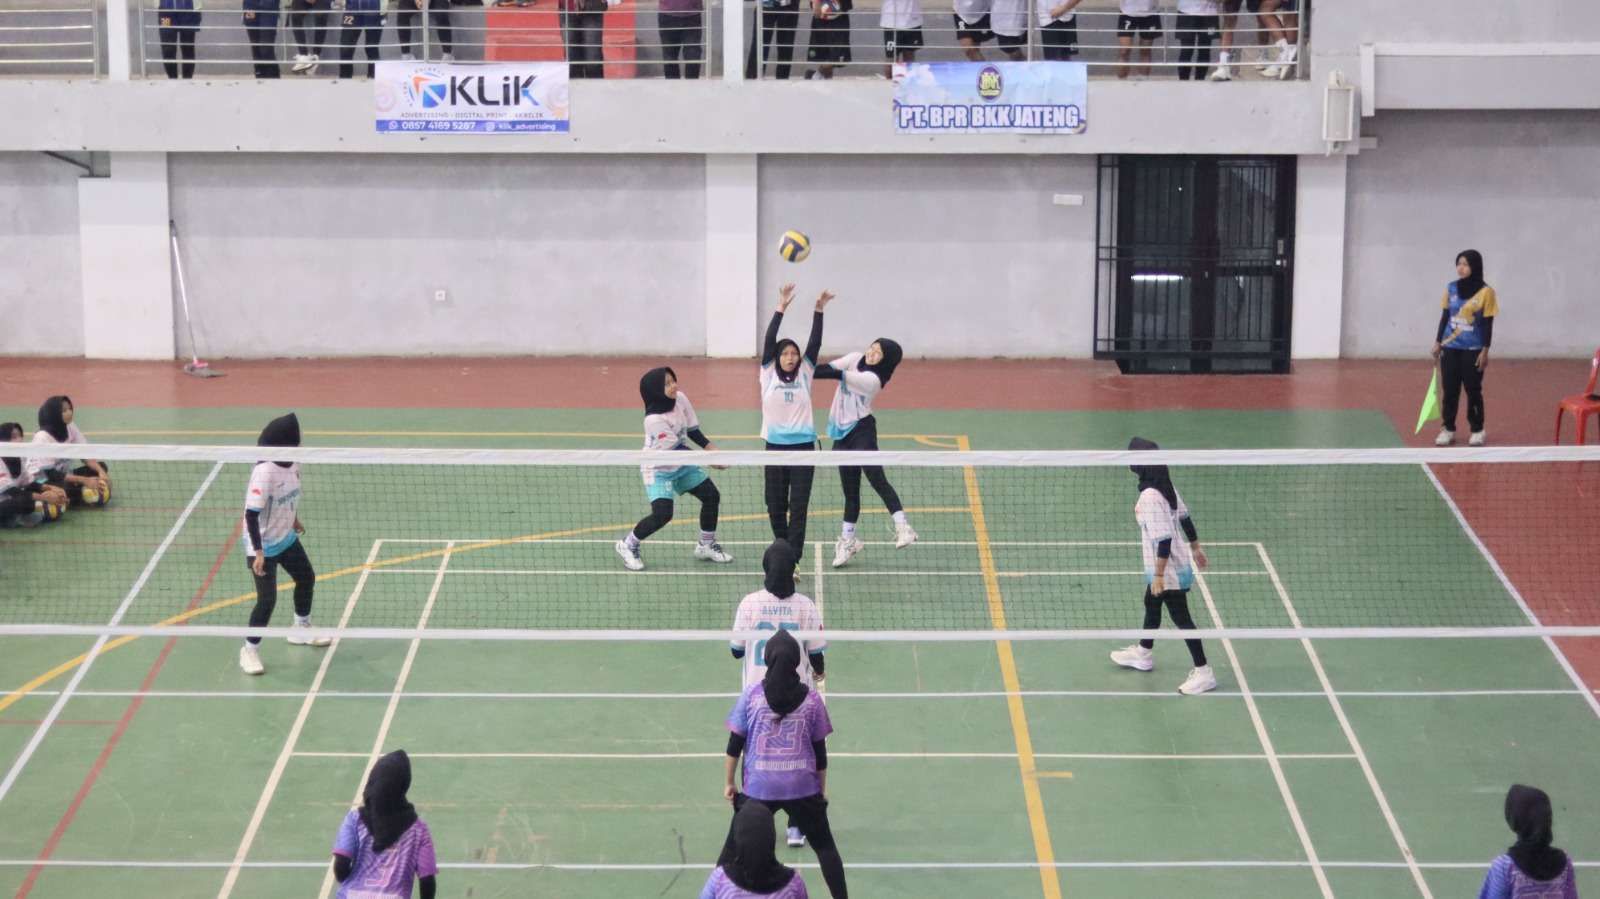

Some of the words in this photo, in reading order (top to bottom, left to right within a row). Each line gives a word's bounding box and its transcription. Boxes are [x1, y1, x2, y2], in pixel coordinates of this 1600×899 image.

[343, 15, 354, 25] 22
[1125, 20, 1132, 30] 7
[900, 105, 928, 128] PT.
[929, 105, 969, 128] BPR
[970, 105, 1011, 128] BKK
[1012, 105, 1080, 128] JATENG
[401, 121, 426, 130] 0857
[452, 121, 476, 130] 5287
[498, 121, 556, 132] klik_advertising
[784, 391, 794, 403] 10
[755, 713, 806, 756] 23
